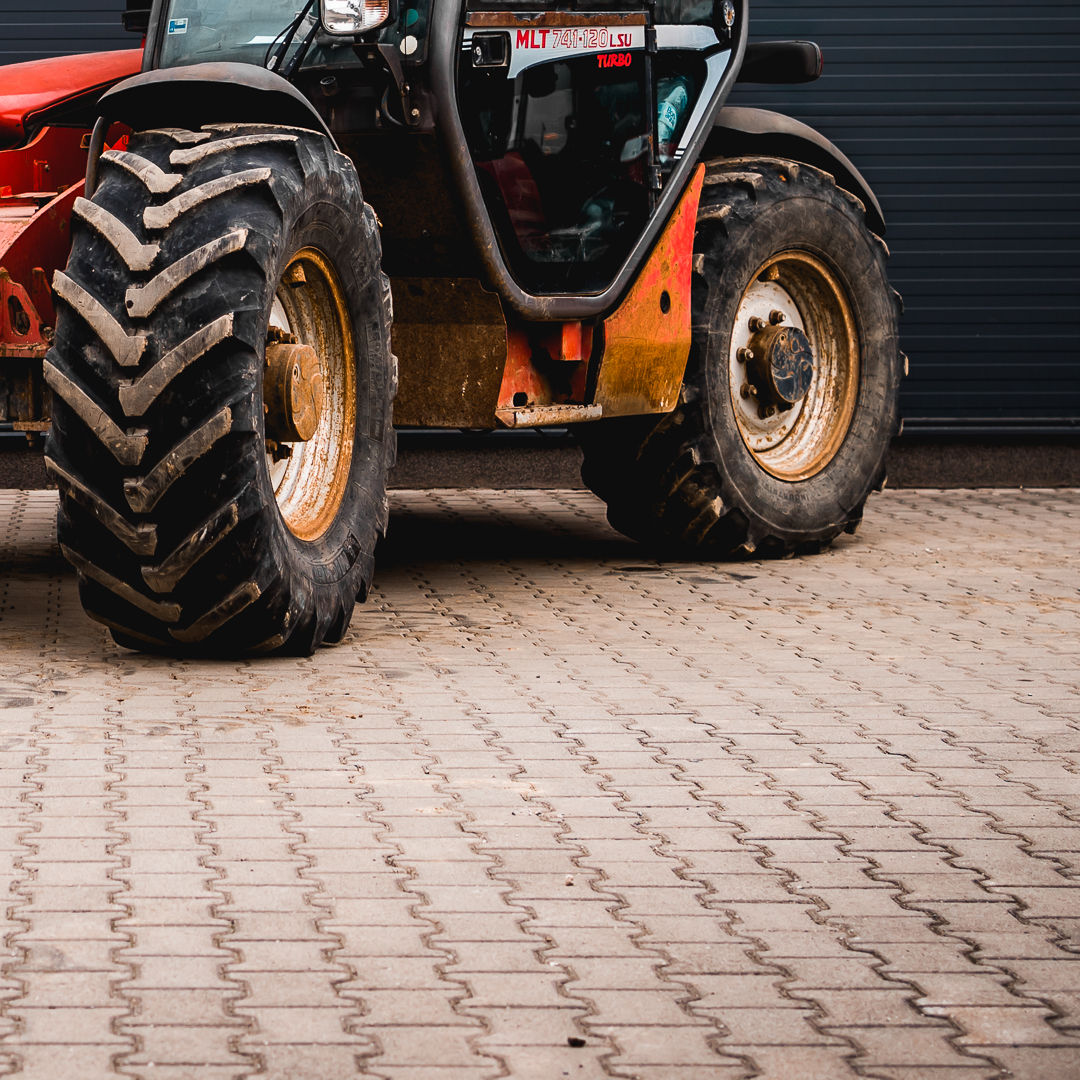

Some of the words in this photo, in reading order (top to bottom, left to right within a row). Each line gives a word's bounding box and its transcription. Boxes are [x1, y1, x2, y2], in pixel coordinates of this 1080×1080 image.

[516, 29, 550, 49] MLT
[610, 33, 632, 48] LSU
[597, 52, 632, 68] TURBO
